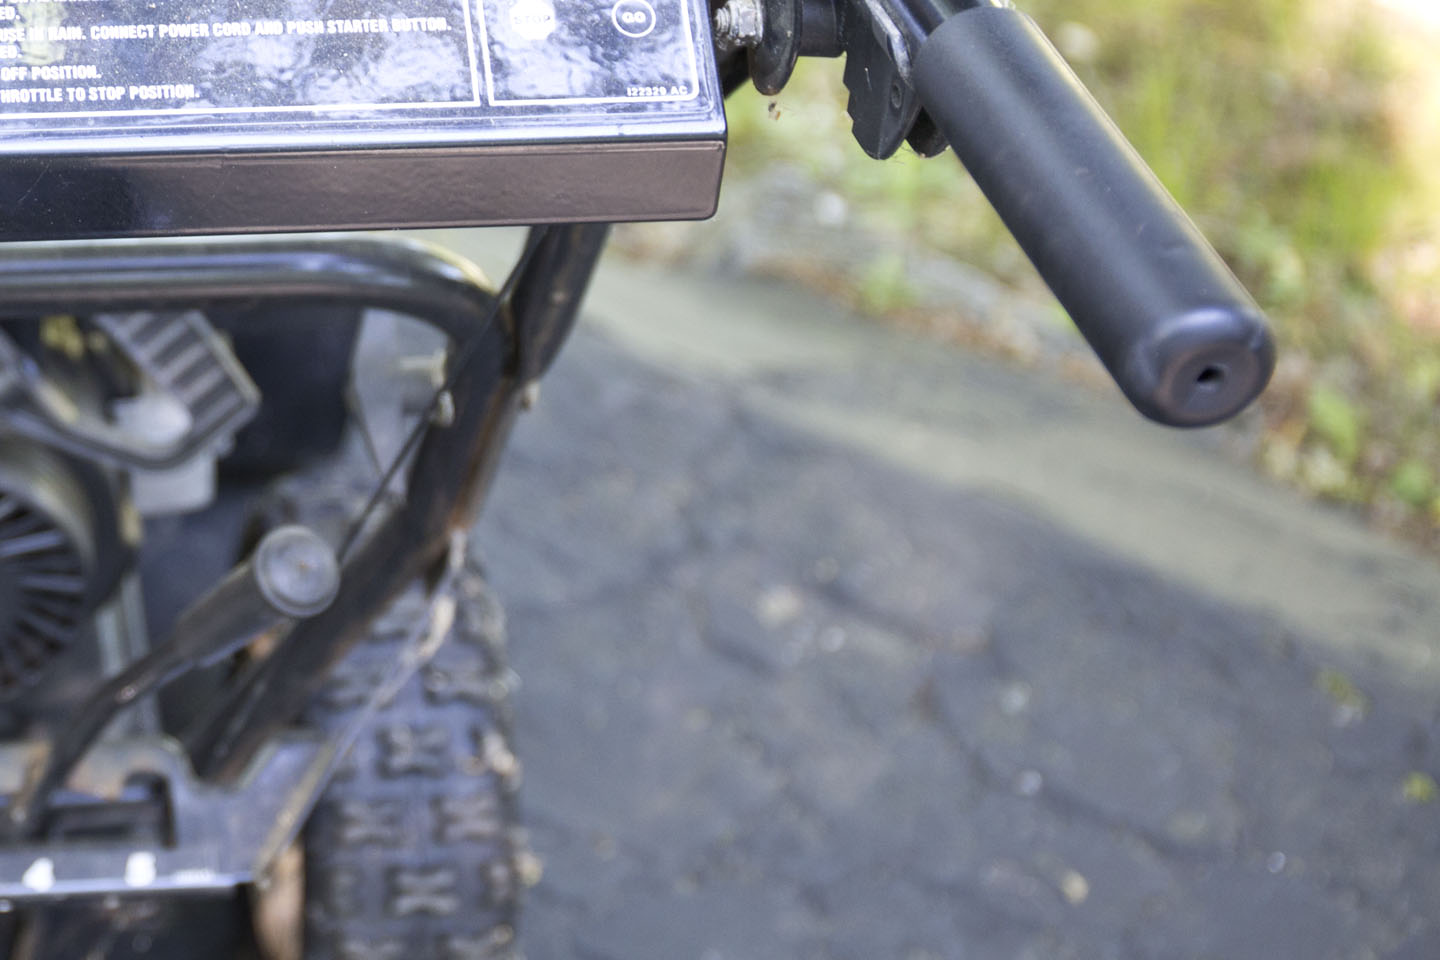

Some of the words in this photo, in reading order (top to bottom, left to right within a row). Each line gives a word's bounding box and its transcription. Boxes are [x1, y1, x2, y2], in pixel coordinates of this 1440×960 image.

[514, 15, 551, 25] STOP
[622, 11, 646, 24] GO
[48, 26, 86, 40] RAIN.
[91, 24, 155, 39] CONNECT
[159, 23, 209, 38] POWER
[212, 22, 251, 37] CORD
[254, 21, 283, 36] AND
[286, 20, 324, 35] PUSH
[327, 19, 389, 34] STARTER
[391, 17, 452, 32] BUTTON.
[0, 67, 27, 81] OFF
[31, 64, 102, 80] POSITION.
[68, 87, 86, 102] TO
[89, 86, 125, 101] STOP
[129, 84, 199, 100] POSITION.
